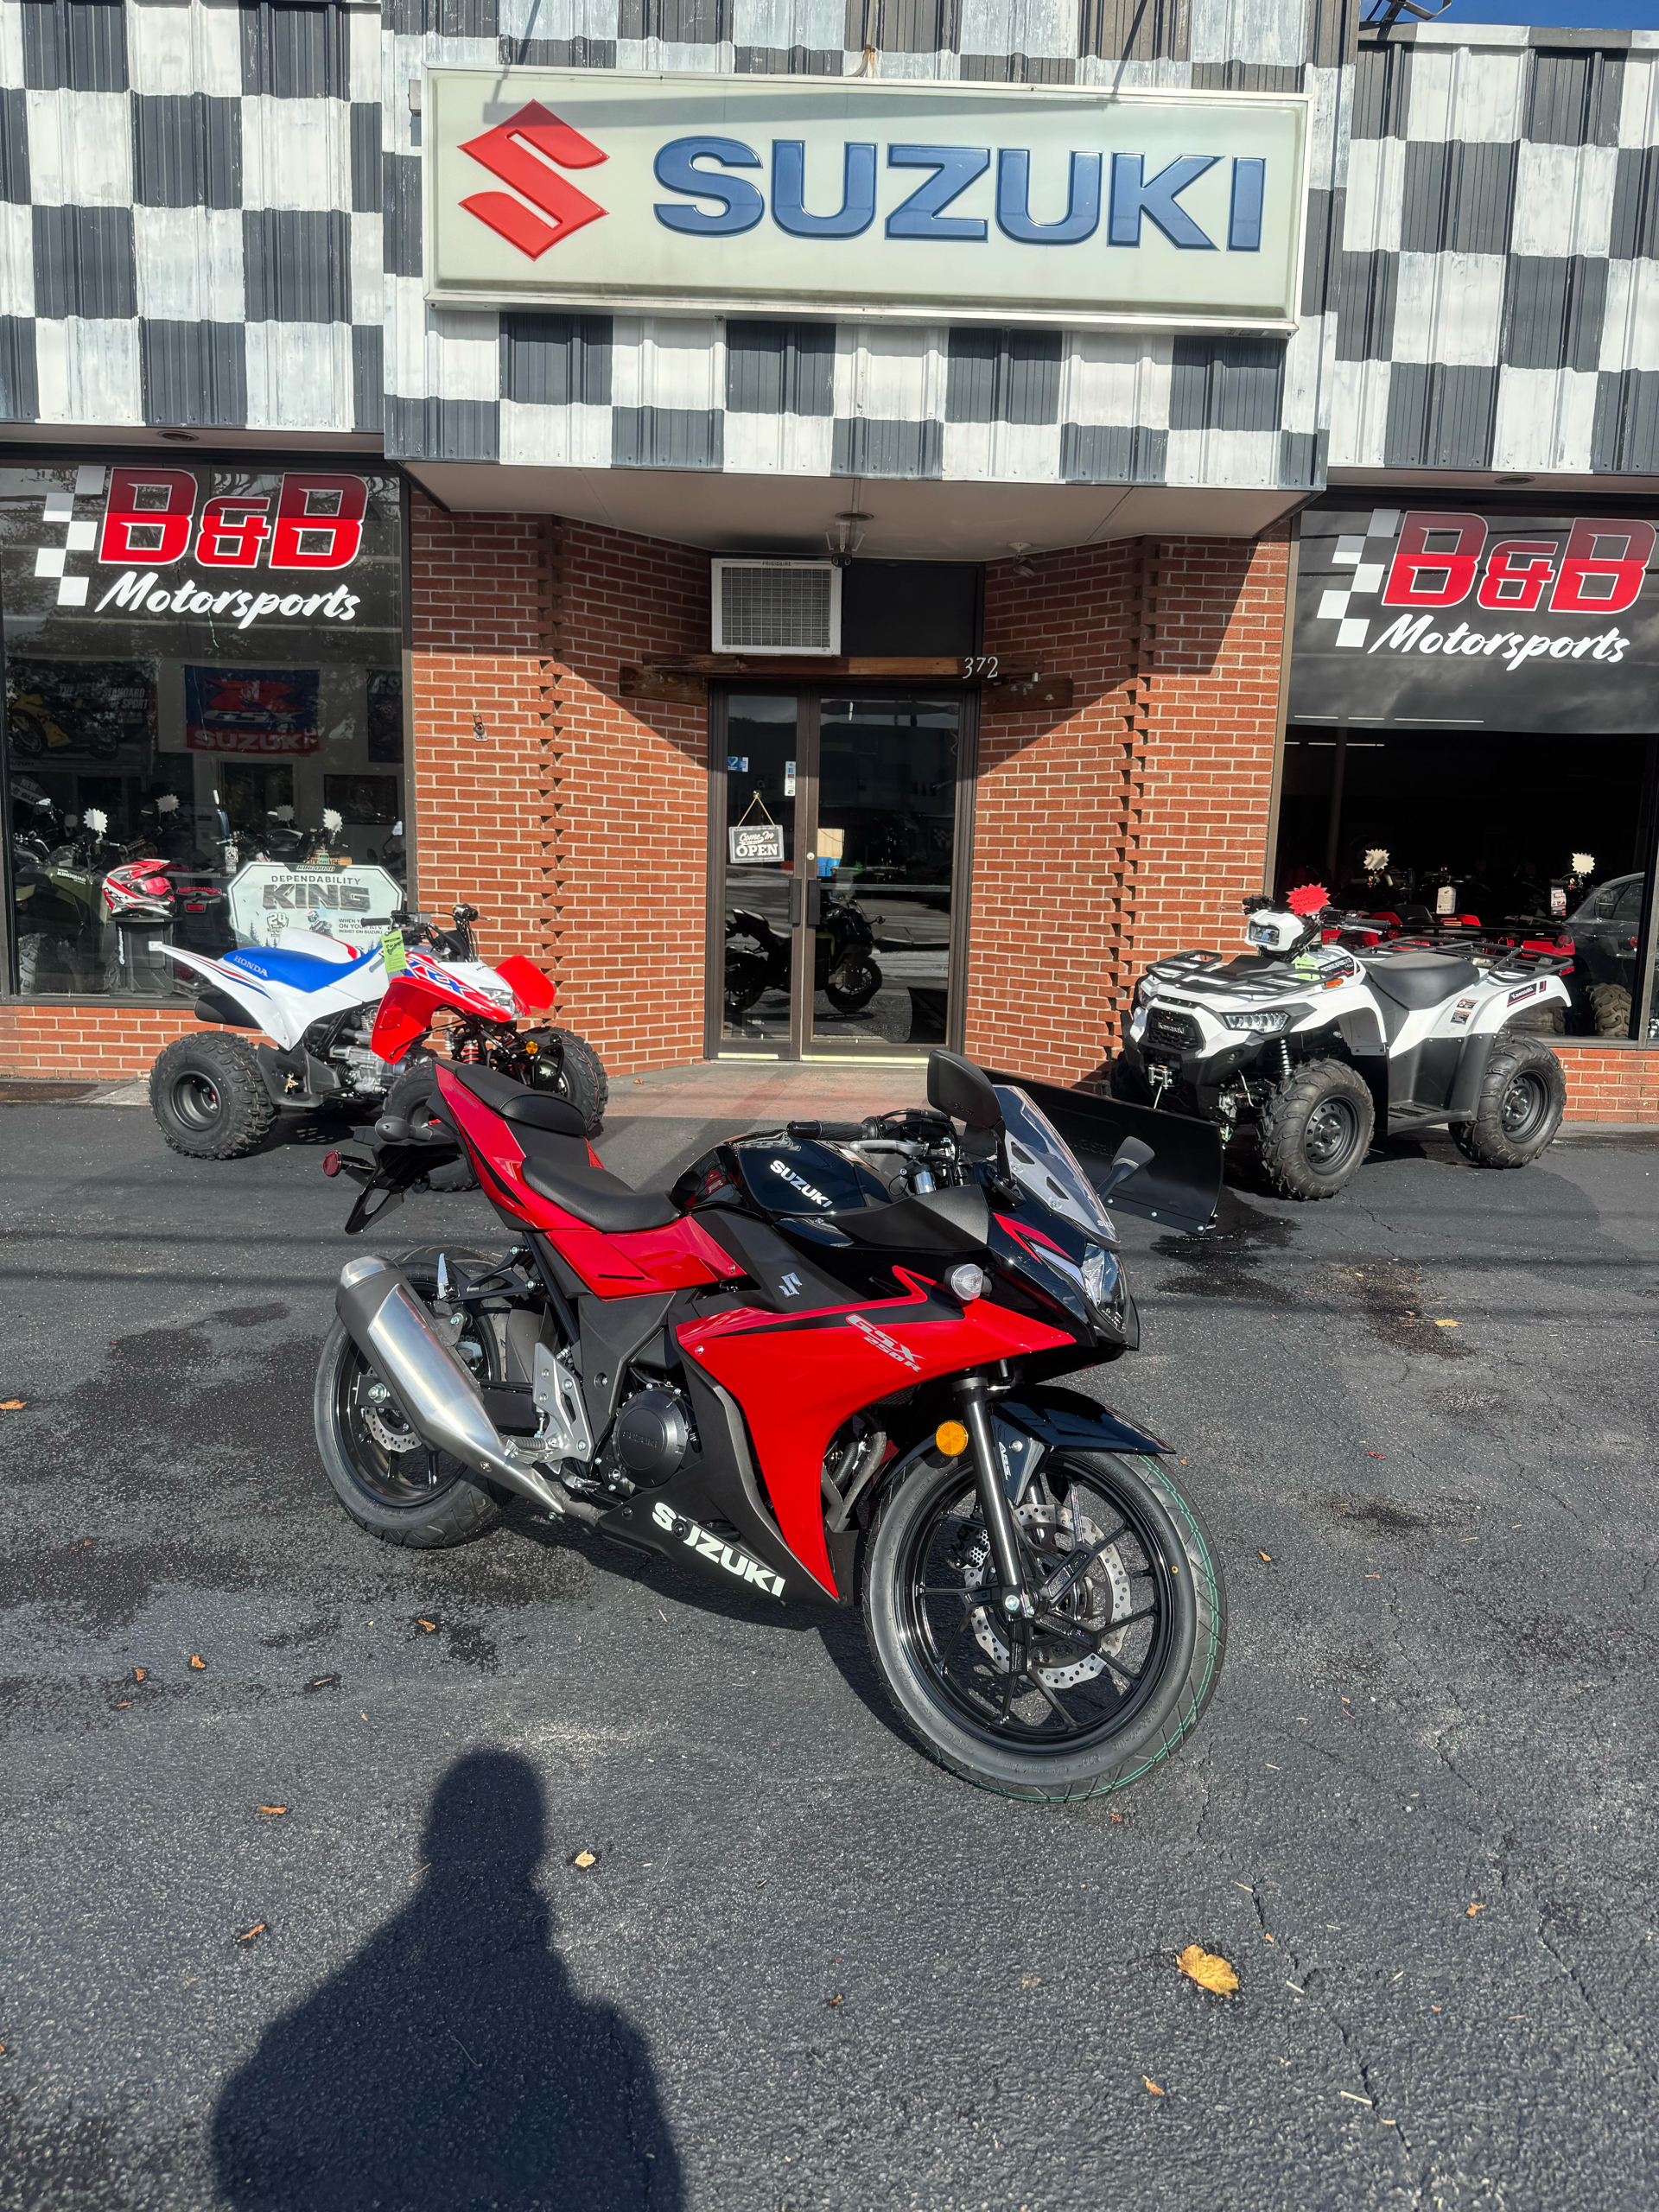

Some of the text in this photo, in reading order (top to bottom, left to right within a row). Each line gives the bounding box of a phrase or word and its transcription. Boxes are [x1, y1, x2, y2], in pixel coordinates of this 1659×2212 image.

[653, 135, 1267, 252] SUZUKI
[98, 466, 369, 571] B&B
[1381, 510, 1658, 615] B&B
[94, 570, 361, 630] Motorsports
[1367, 613, 1630, 671] Motorsports
[962, 656, 999, 679] 372
[122, 699, 149, 709] SPORT
[735, 844, 779, 857] OPEN
[739, 830, 775, 842] Come In
[270, 875, 361, 886] DEPENDABILITY
[263, 883, 372, 913] KING
[233, 954, 269, 977] HONDA
[1511, 986, 1534, 1000] Kawasaki
[1158, 1021, 1185, 1034] Kawasaki
[770, 1160, 833, 1208] SUZUKI
[847, 1314, 927, 1366] GSX
[862, 1335, 922, 1372] 250R
[622, 1430, 659, 1448] SUZUKI
[998, 1441, 1012, 1481] ABS
[1127, 1482, 1172, 1545] WINNER
